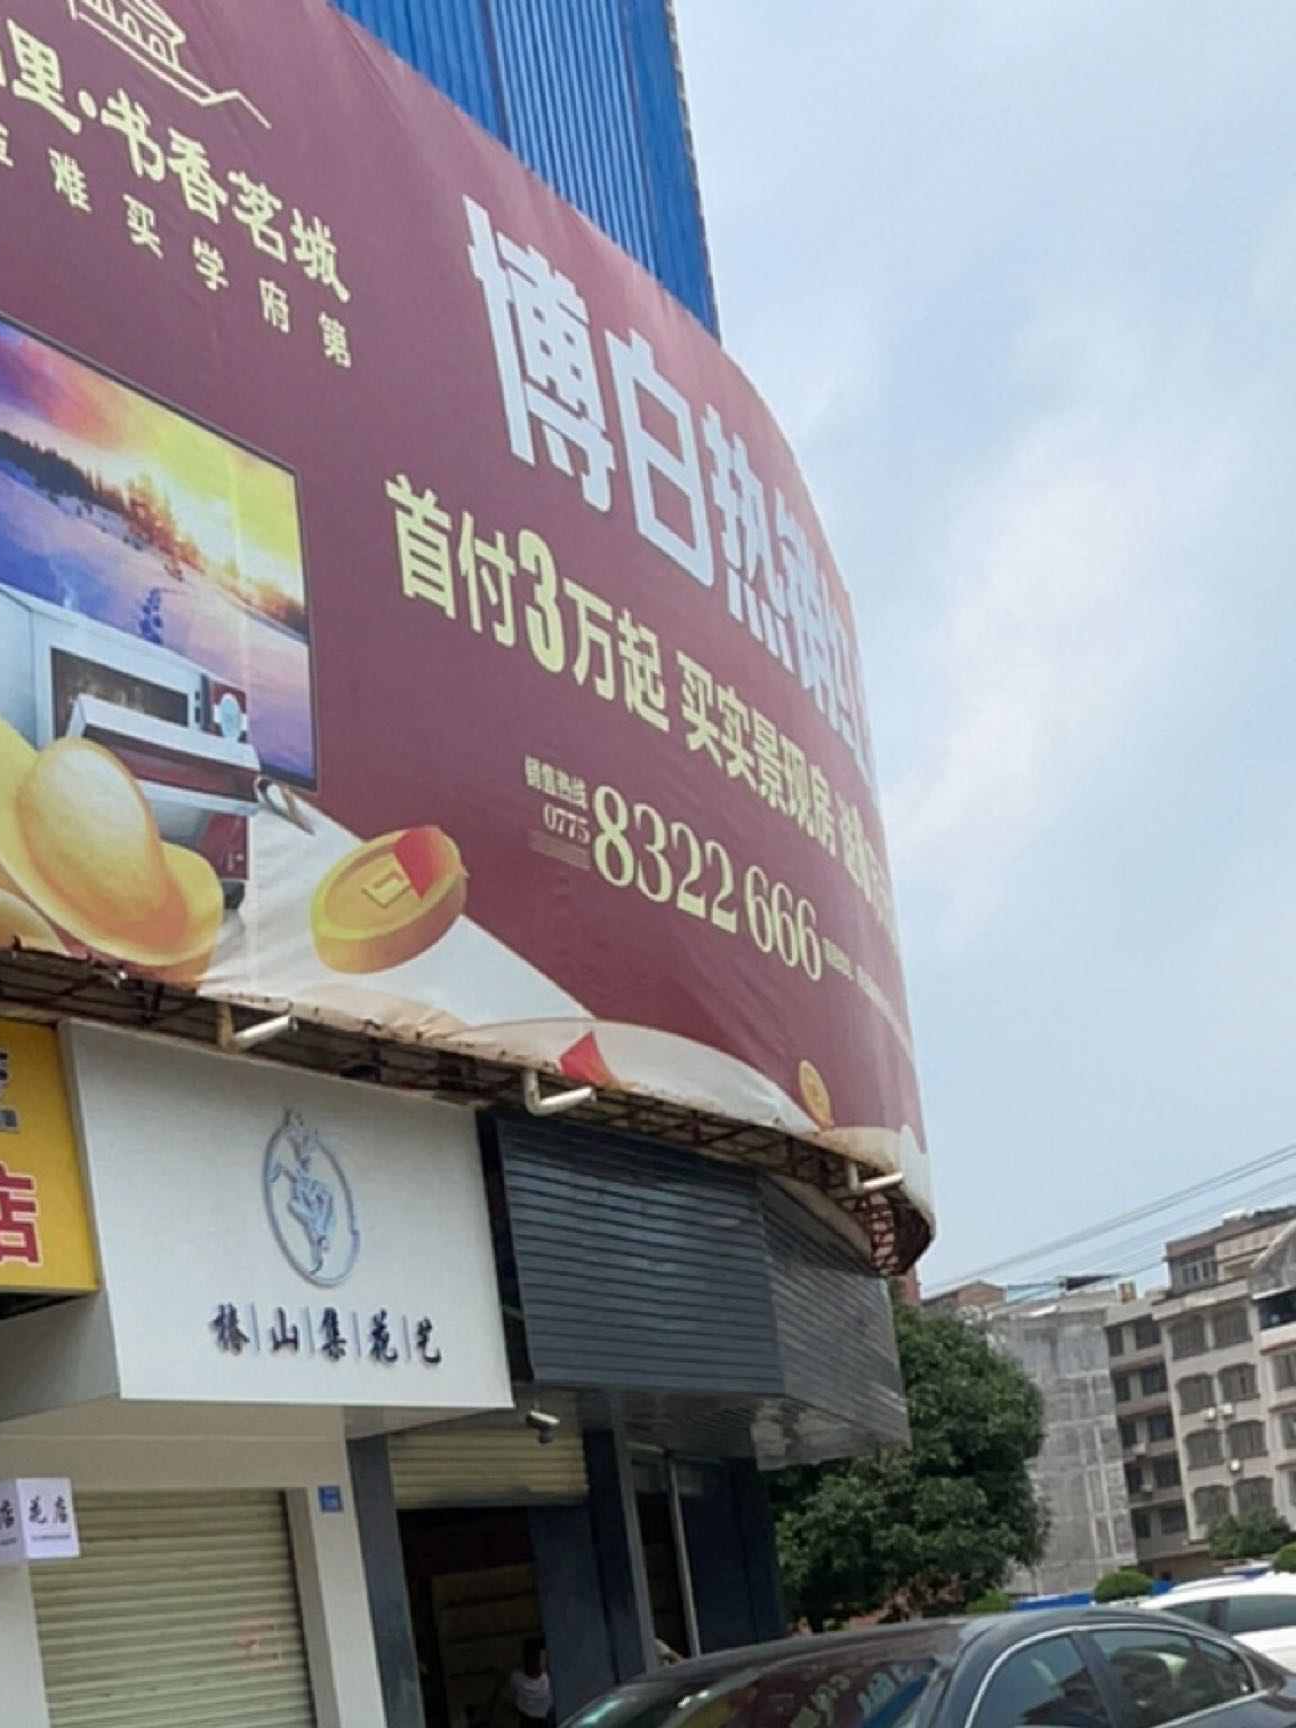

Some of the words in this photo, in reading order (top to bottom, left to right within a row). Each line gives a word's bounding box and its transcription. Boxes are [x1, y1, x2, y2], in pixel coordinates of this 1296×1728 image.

[384, 473, 671, 732] 首付3万起
[543, 804, 592, 844] 0775
